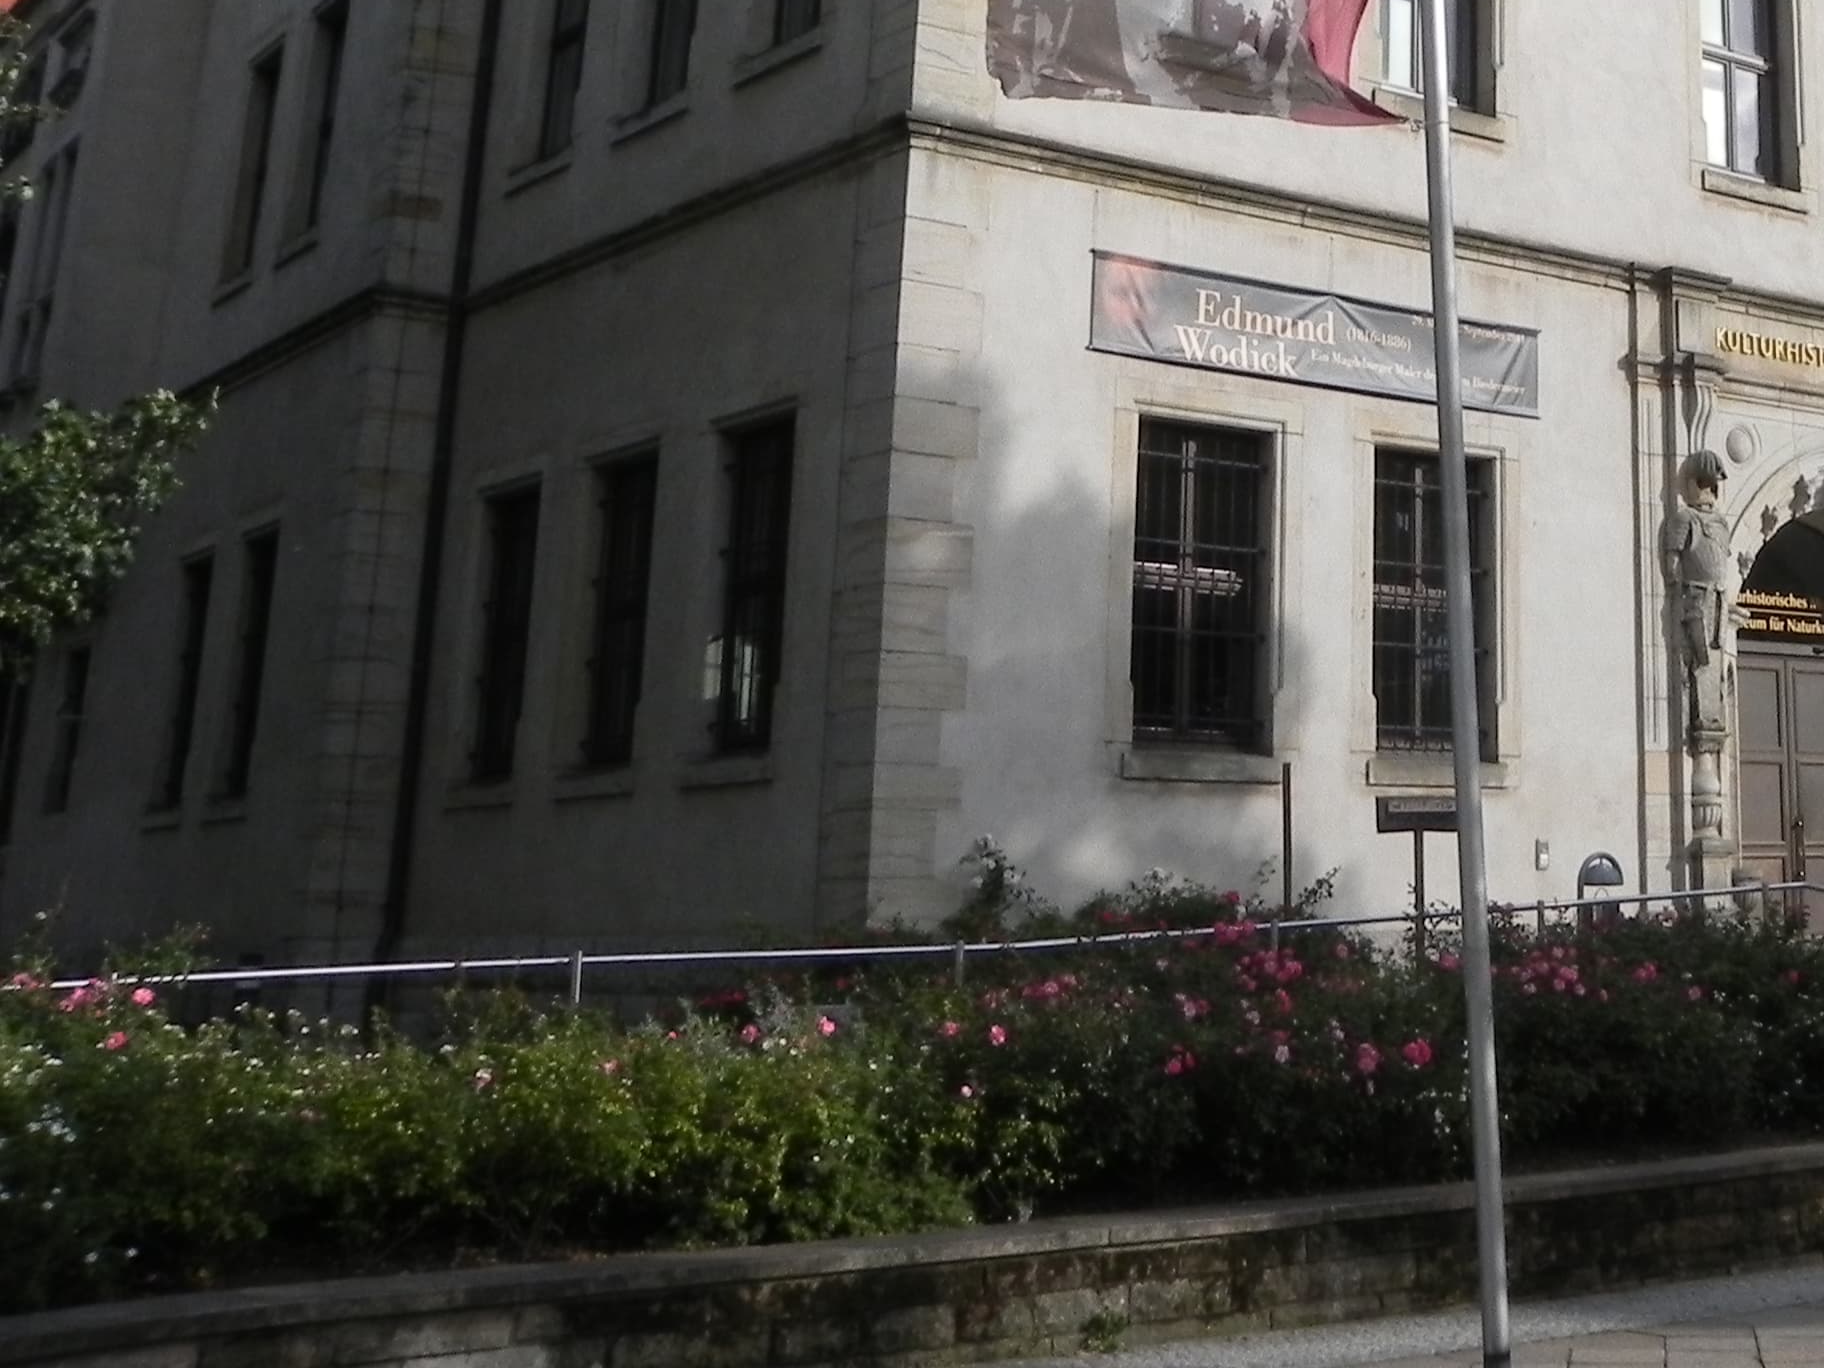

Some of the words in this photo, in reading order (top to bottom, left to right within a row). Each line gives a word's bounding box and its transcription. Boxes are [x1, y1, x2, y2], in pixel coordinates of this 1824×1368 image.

[1195, 288, 1337, 346] Edmund
[1174, 325, 1299, 378] Wodick
[1737, 588, 1809, 609] urhistorisches
[1769, 615, 1785, 632] für
